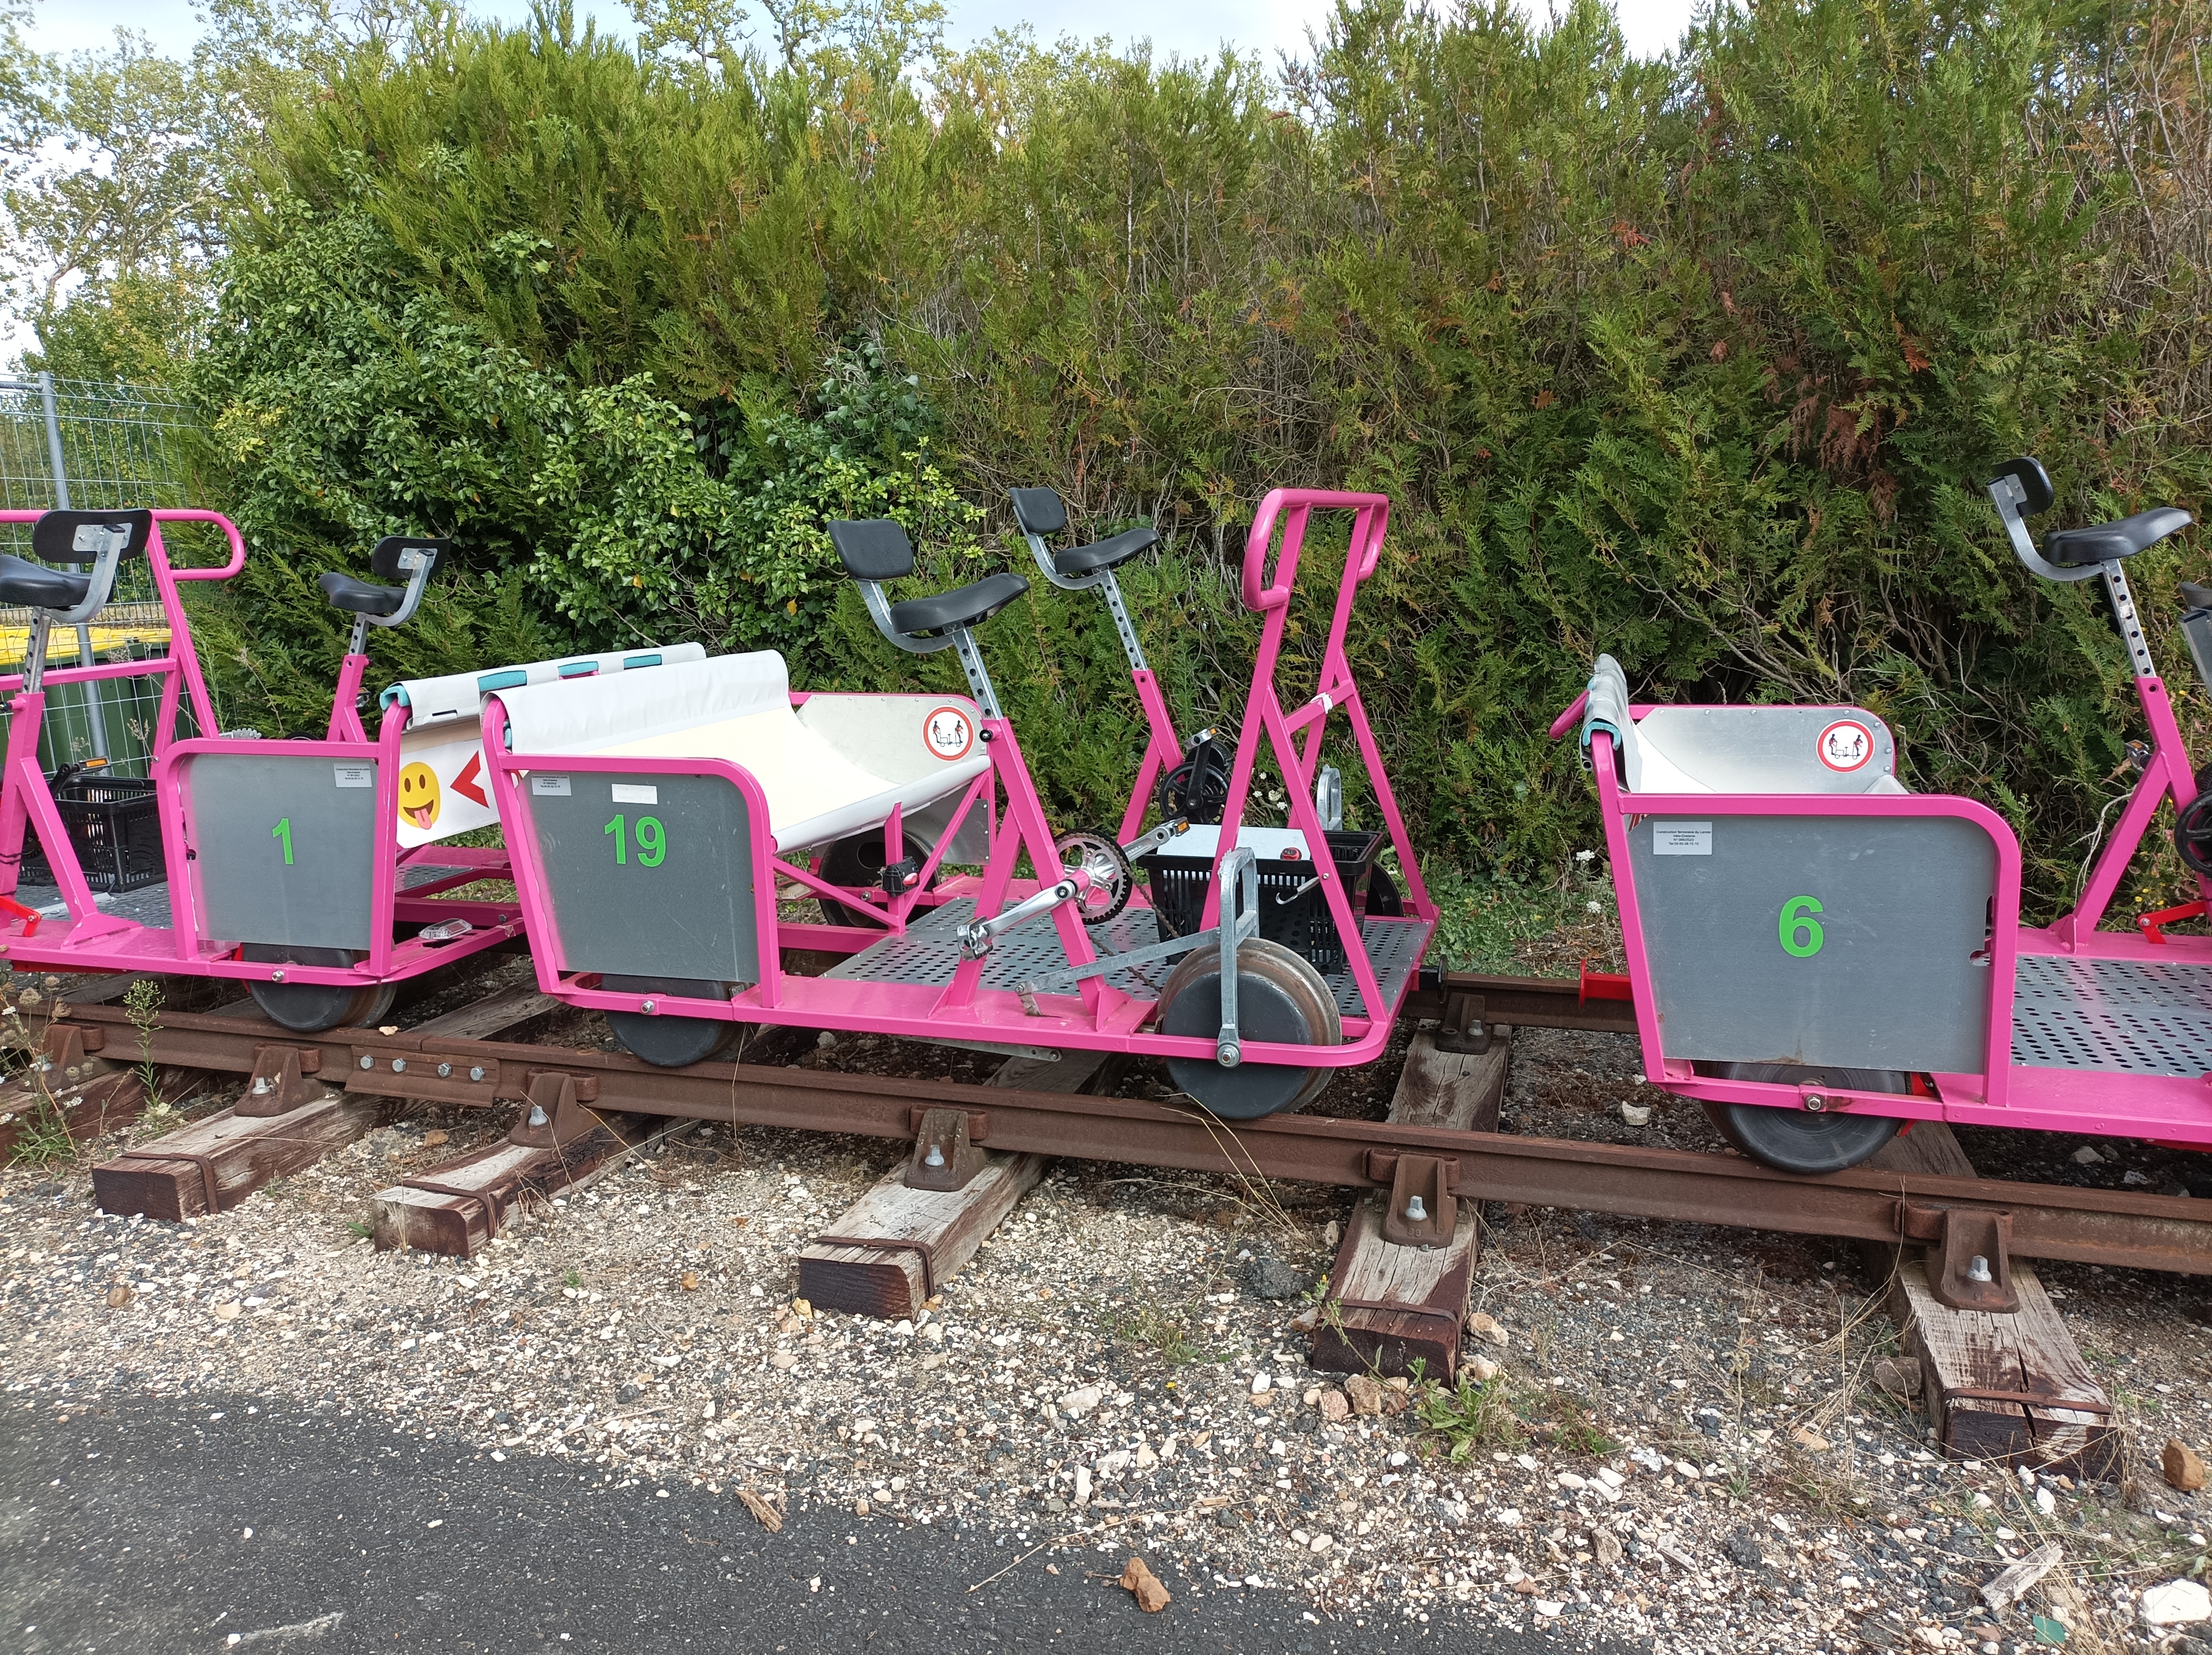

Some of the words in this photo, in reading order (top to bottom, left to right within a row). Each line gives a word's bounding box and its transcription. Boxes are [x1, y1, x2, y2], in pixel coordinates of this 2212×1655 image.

[272, 818, 294, 865] 1
[604, 814, 666, 867] 19
[1779, 895, 1824, 957] 6
